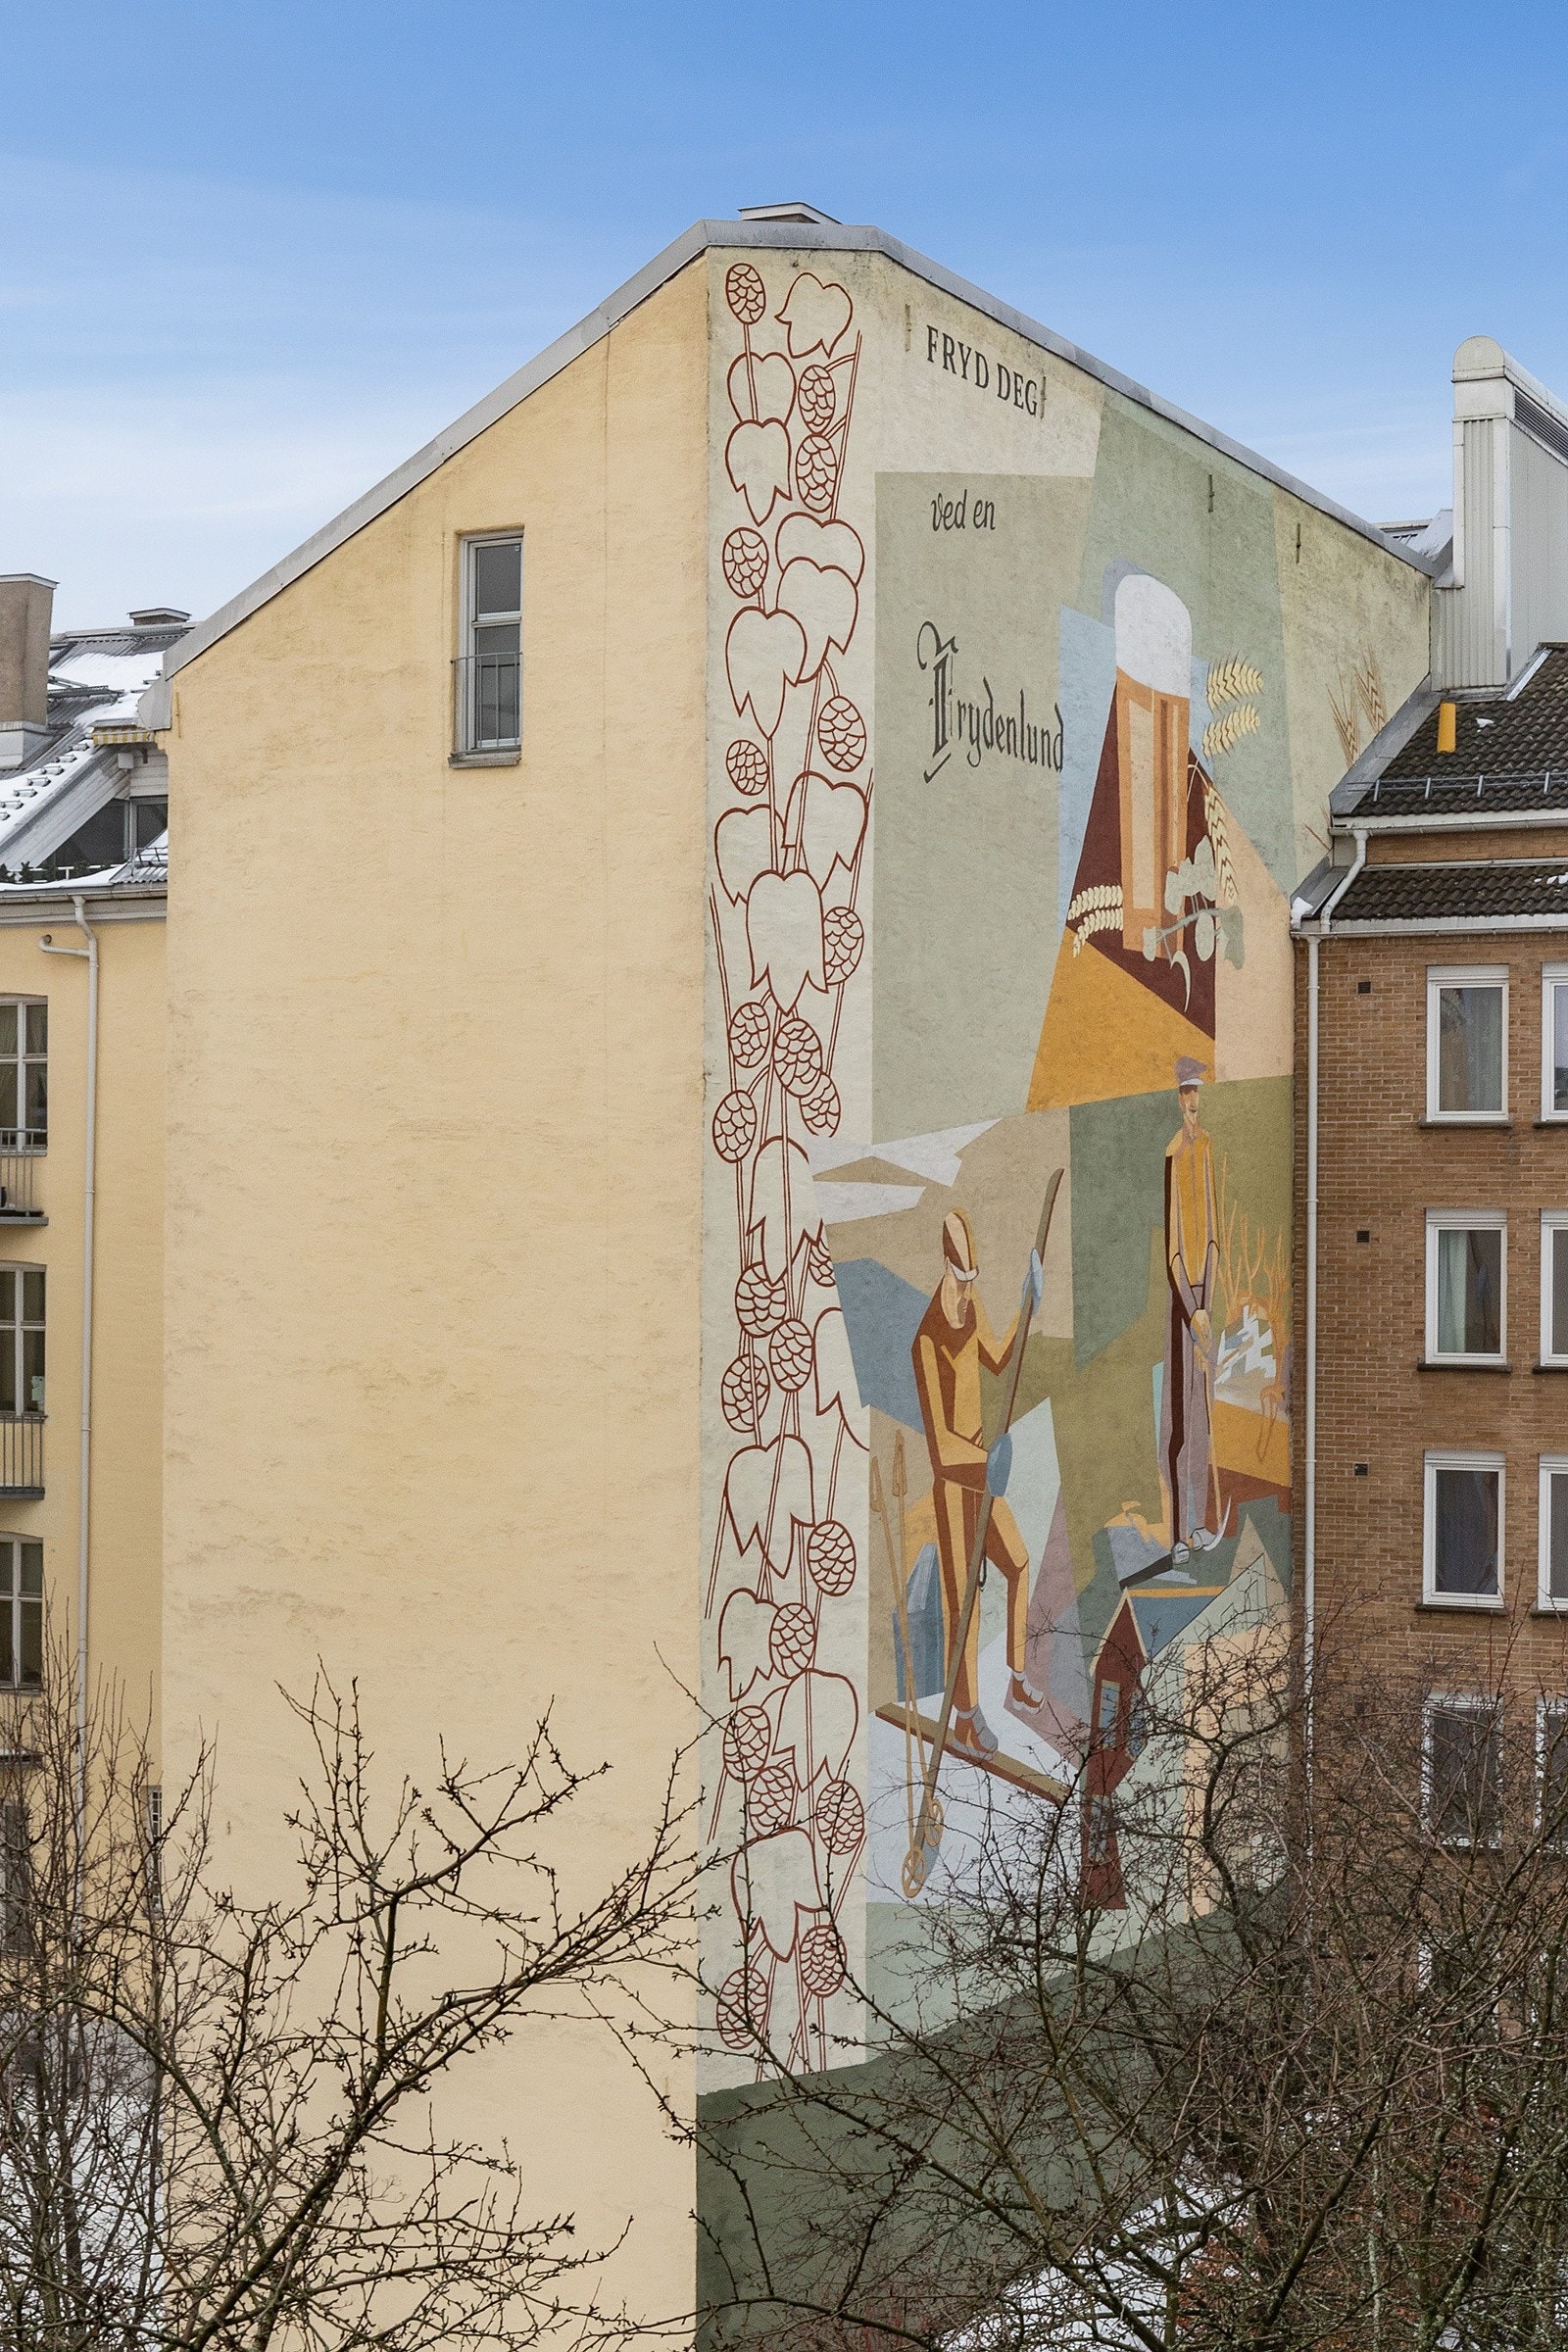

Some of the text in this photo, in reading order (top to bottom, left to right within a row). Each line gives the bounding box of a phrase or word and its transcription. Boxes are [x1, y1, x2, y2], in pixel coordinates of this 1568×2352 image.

[926, 324, 1039, 416] FRYD DEG
[930, 489, 996, 532] ved en
[917, 620, 1064, 783] Frydenlund
